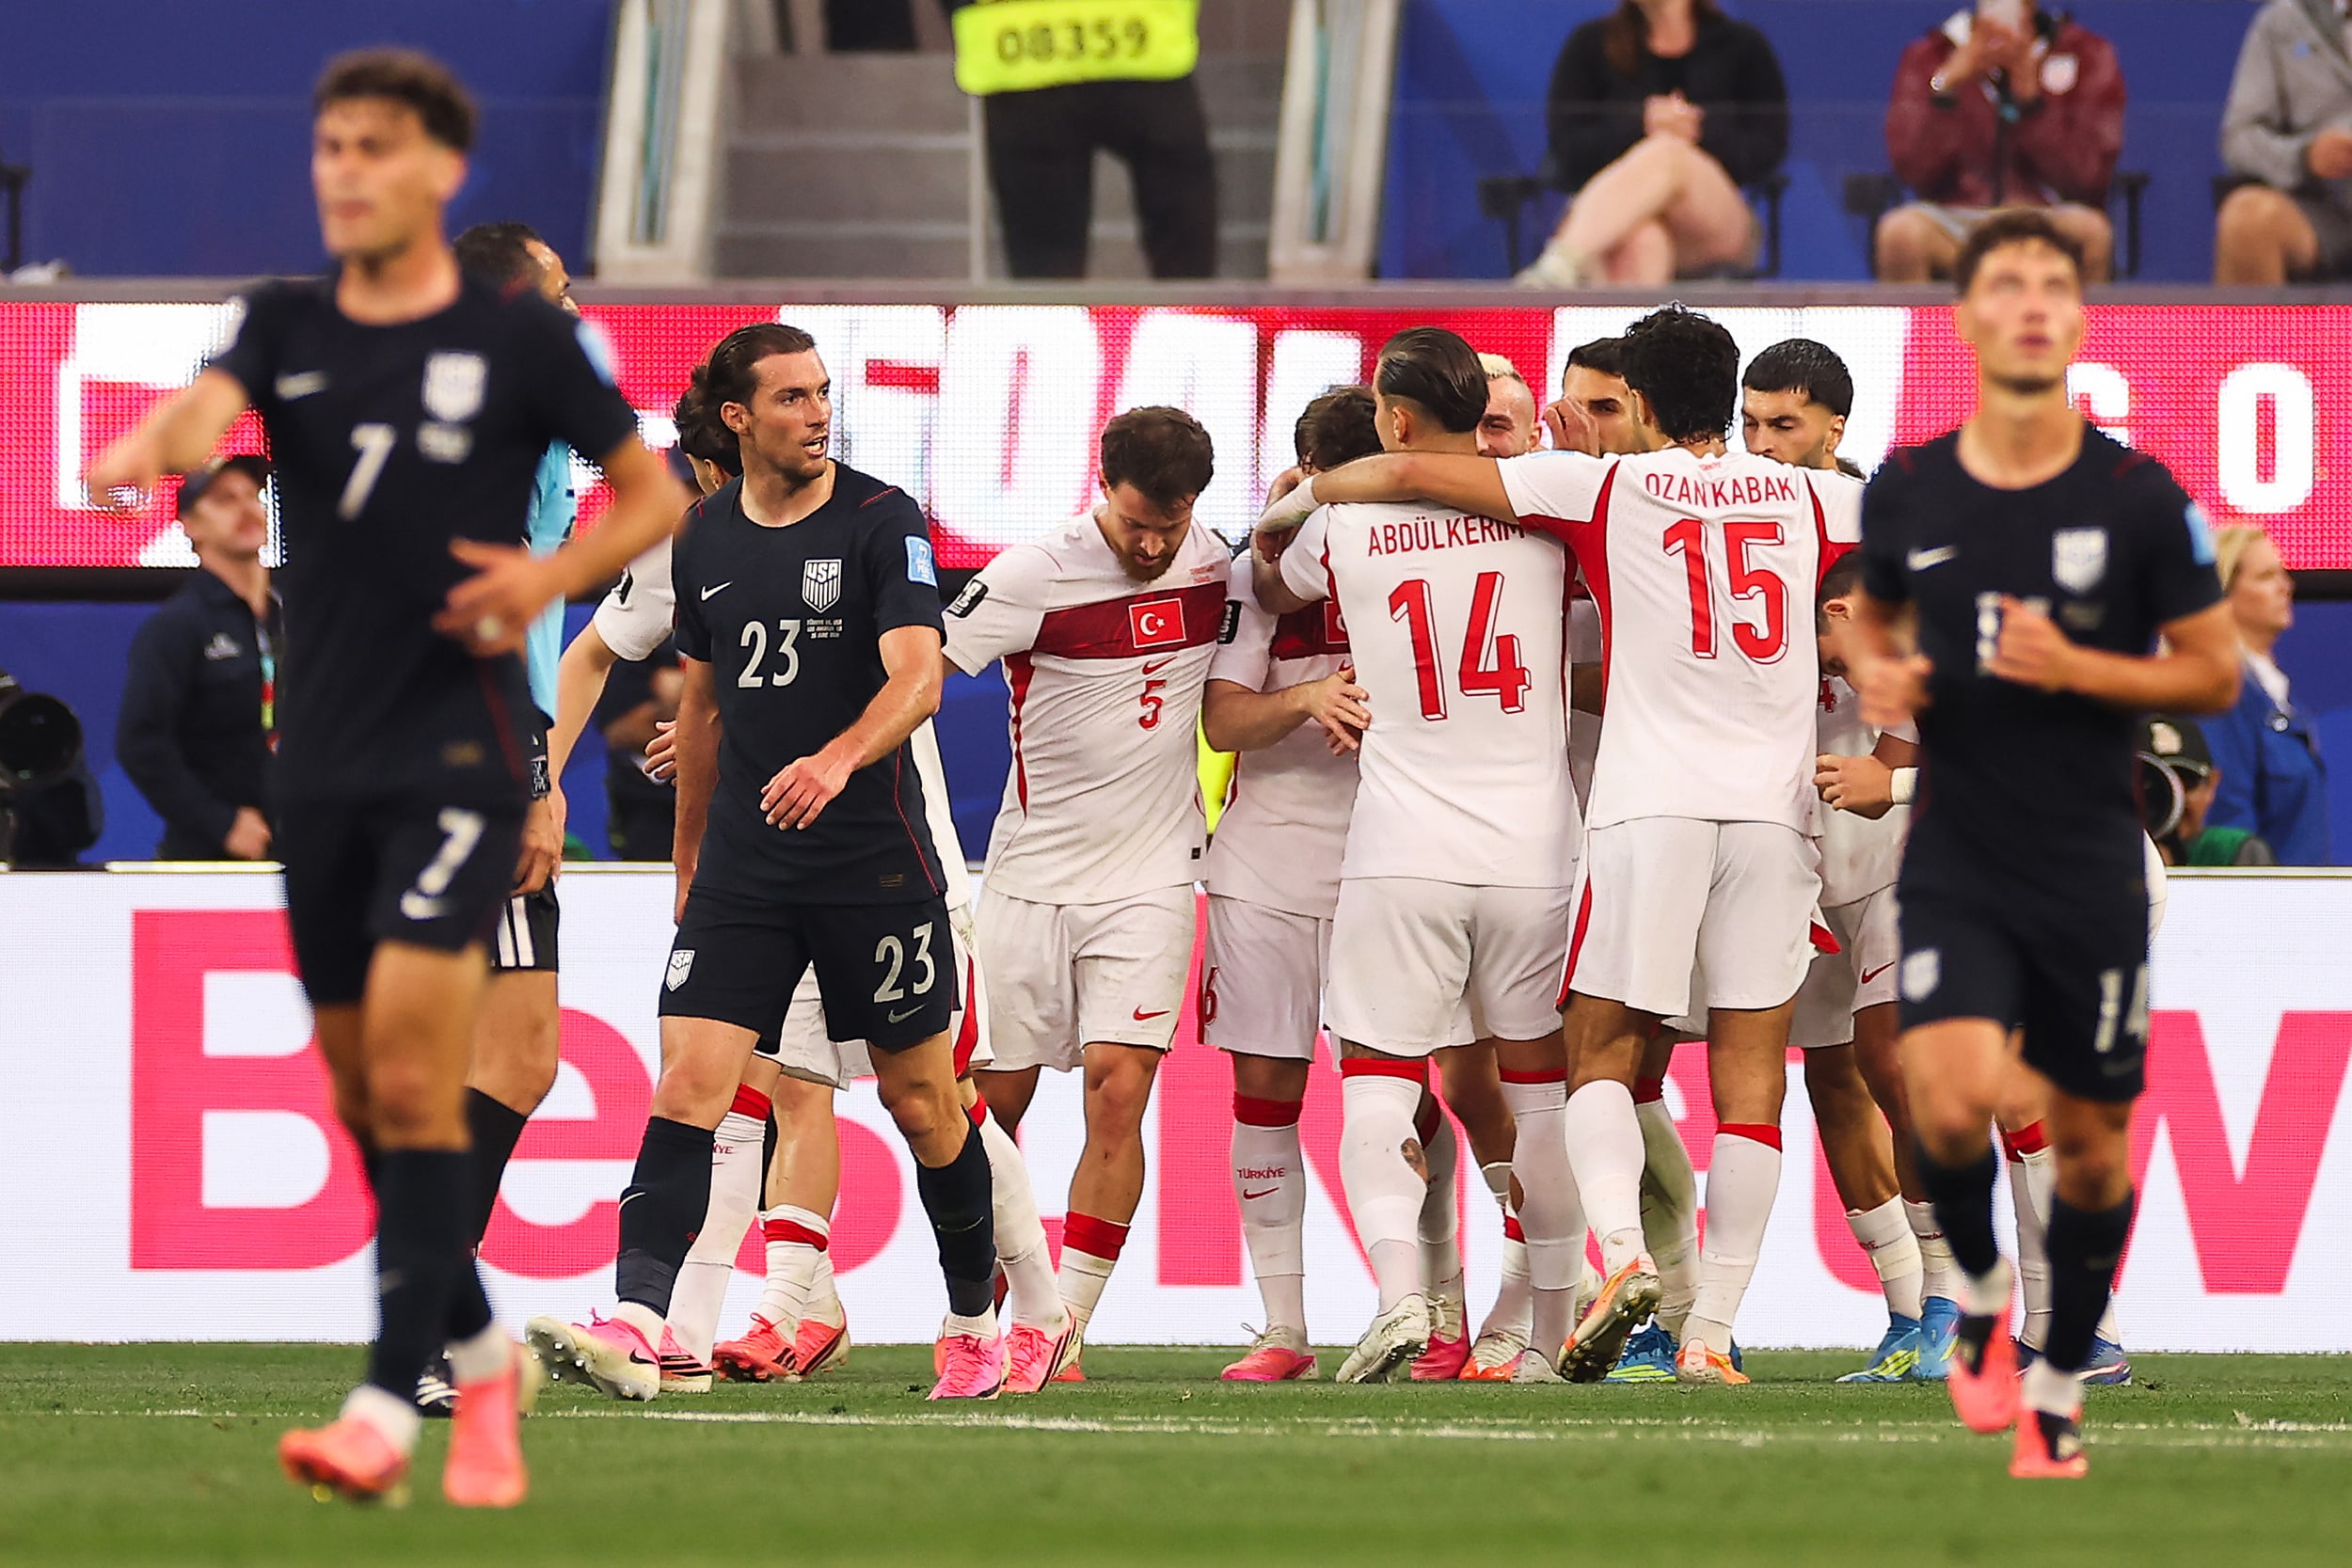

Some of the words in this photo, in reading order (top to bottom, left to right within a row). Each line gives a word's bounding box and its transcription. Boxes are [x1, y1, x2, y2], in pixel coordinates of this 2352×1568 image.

[996, 14, 1149, 65] 08359
[337, 421, 396, 522] 7
[1645, 473, 1708, 508] OZAN
[1711, 476, 1796, 508] KABAK
[806, 562, 839, 584] USA
[1663, 518, 1789, 665] 15
[739, 619, 801, 689] 23
[1388, 571, 1532, 722] 14
[1138, 679, 1167, 731] 5
[417, 806, 486, 895] 7
[874, 921, 935, 1003] 23
